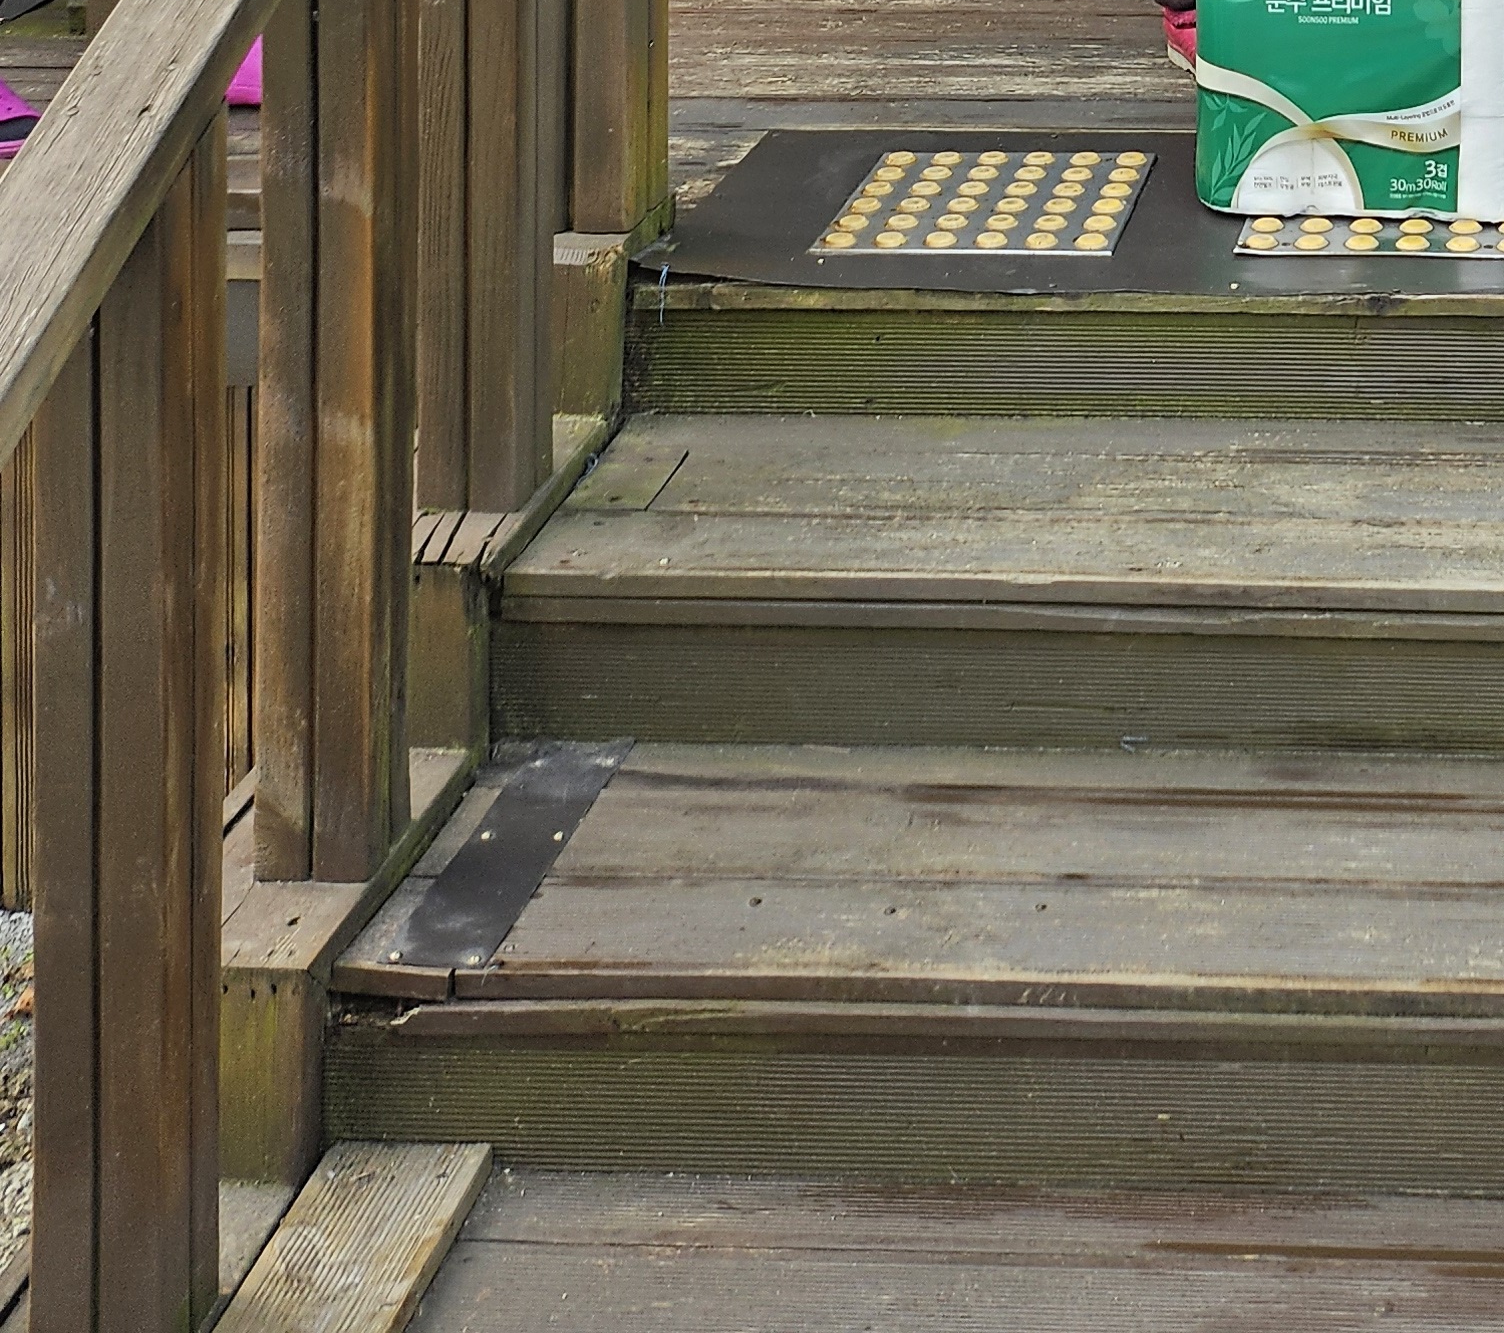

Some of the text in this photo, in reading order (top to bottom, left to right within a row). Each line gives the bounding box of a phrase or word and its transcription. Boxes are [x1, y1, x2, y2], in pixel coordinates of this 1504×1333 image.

[1298, 15, 1359, 25] SOONSOO PREMIUM
[1391, 128, 1449, 143] PREMIUM
[1425, 160, 1448, 178] 3겹
